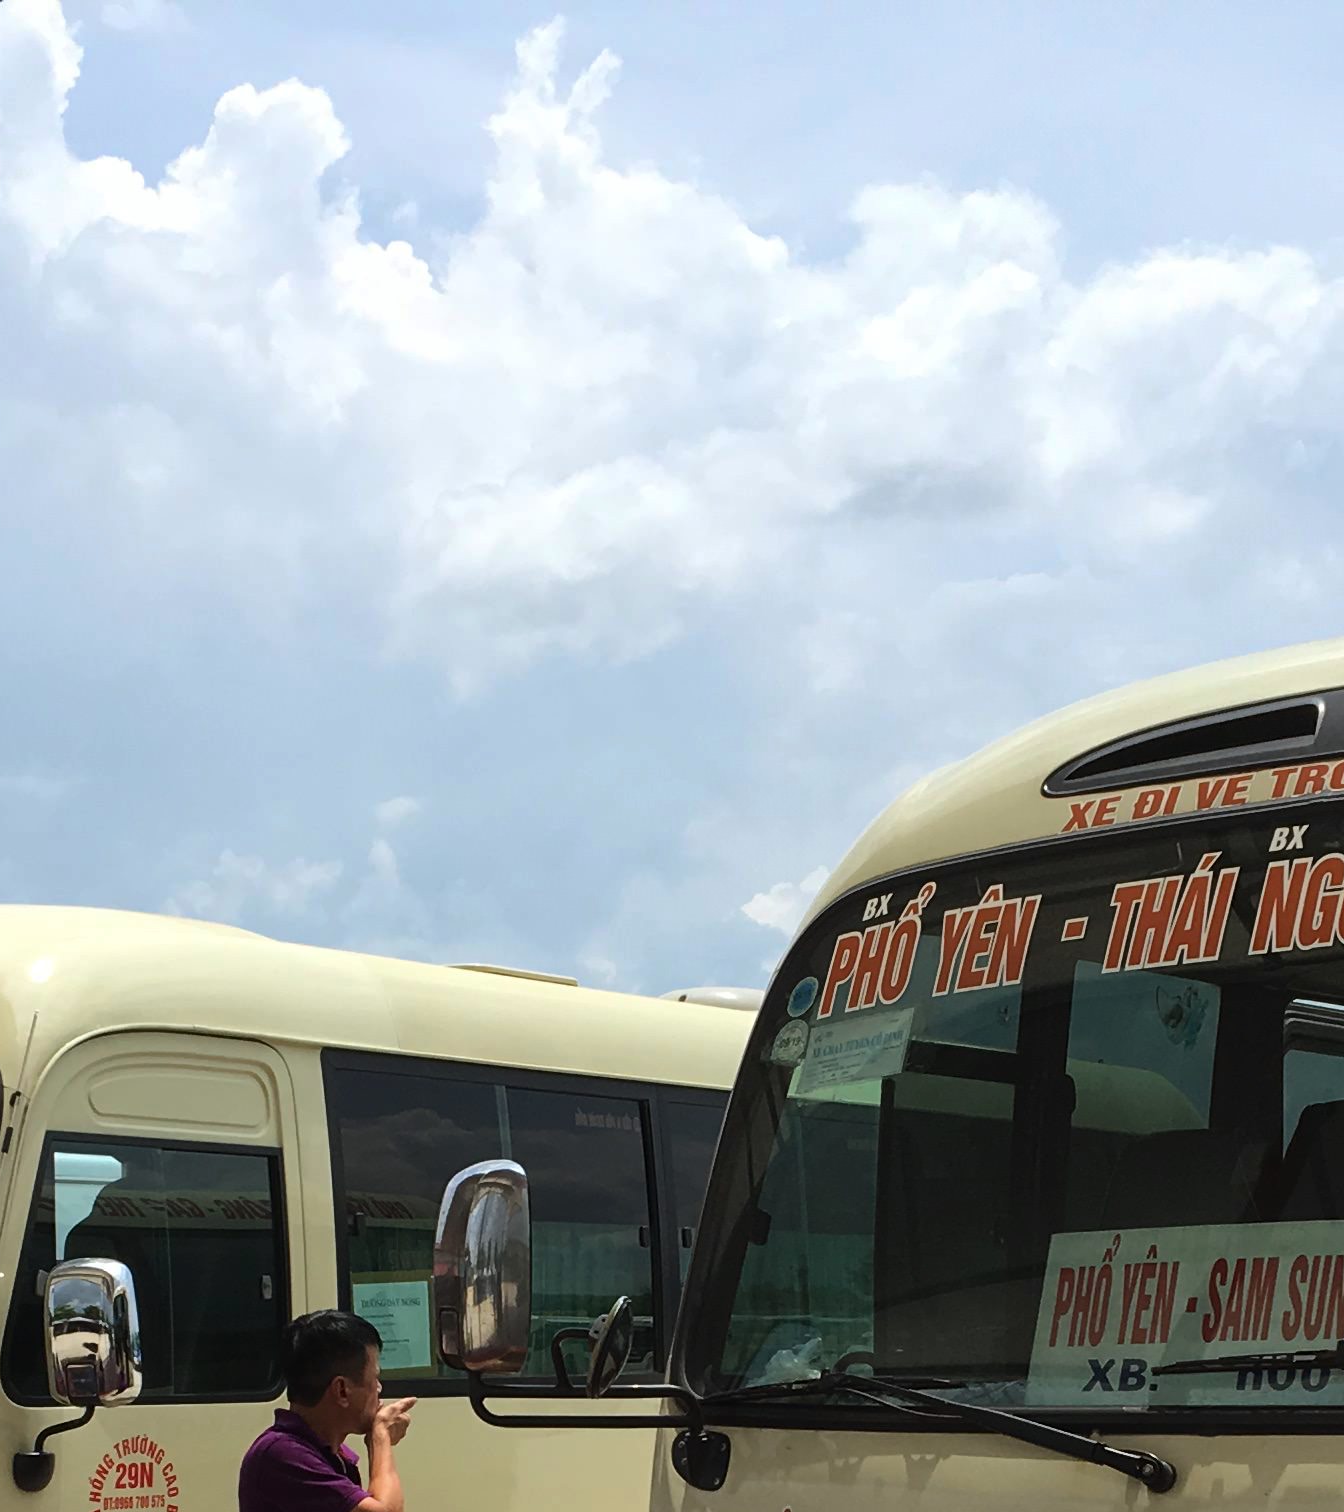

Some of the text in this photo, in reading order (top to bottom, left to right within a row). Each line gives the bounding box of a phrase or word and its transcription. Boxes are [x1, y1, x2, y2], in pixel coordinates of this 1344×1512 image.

[1061, 798, 1117, 834] XE
[1131, 787, 1180, 819] ĐI
[1269, 825, 1309, 853] BX
[862, 893, 893, 922] BX
[816, 881, 936, 1020] PHỔ
[932, 883, 1042, 998] YÊN
[1102, 851, 1239, 975] THÁI
[1049, 1233, 1122, 1348] PHỔ
[1117, 1244, 1180, 1345] YÊN
[1202, 1256, 1280, 1343] SAM
[1081, 1357, 1159, 1393] XB:
[115, 1462, 154, 1490] 29N
[162, 1463, 179, 1498] CAO
